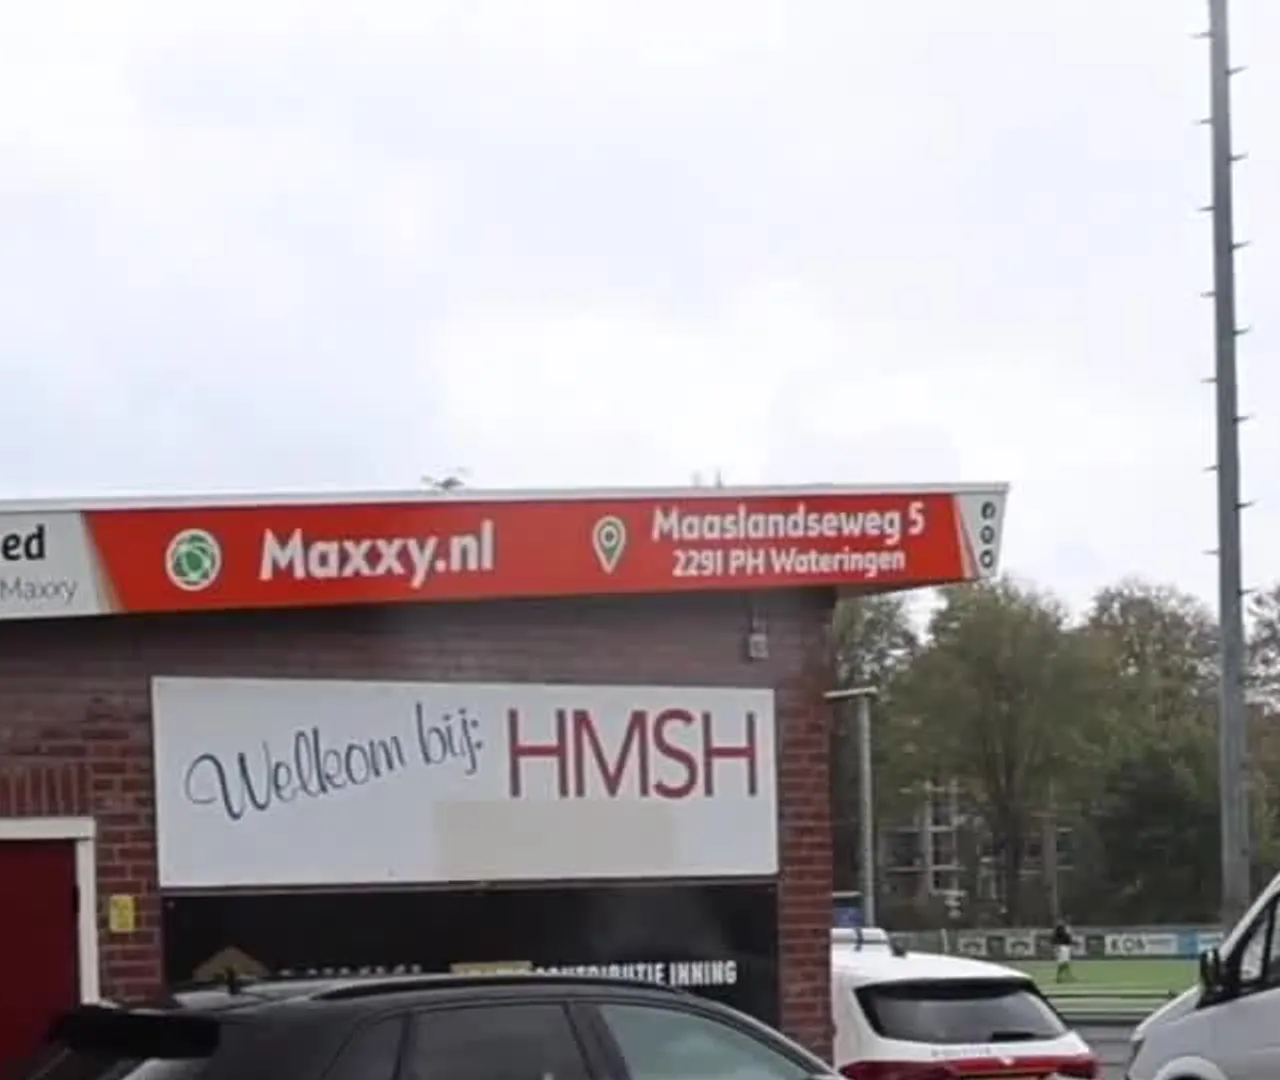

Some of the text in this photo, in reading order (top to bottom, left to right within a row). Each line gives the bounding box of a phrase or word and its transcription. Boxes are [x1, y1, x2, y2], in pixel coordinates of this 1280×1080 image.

[651, 501, 926, 545] Maaslandseweg 5
[258, 518, 494, 589] Maxxy.nl
[671, 546, 907, 579] 2291 PH Wateringen
[184, 724, 408, 821] Welkom
[506, 707, 759, 800] HMSH
[669, 960, 738, 987] INNING
